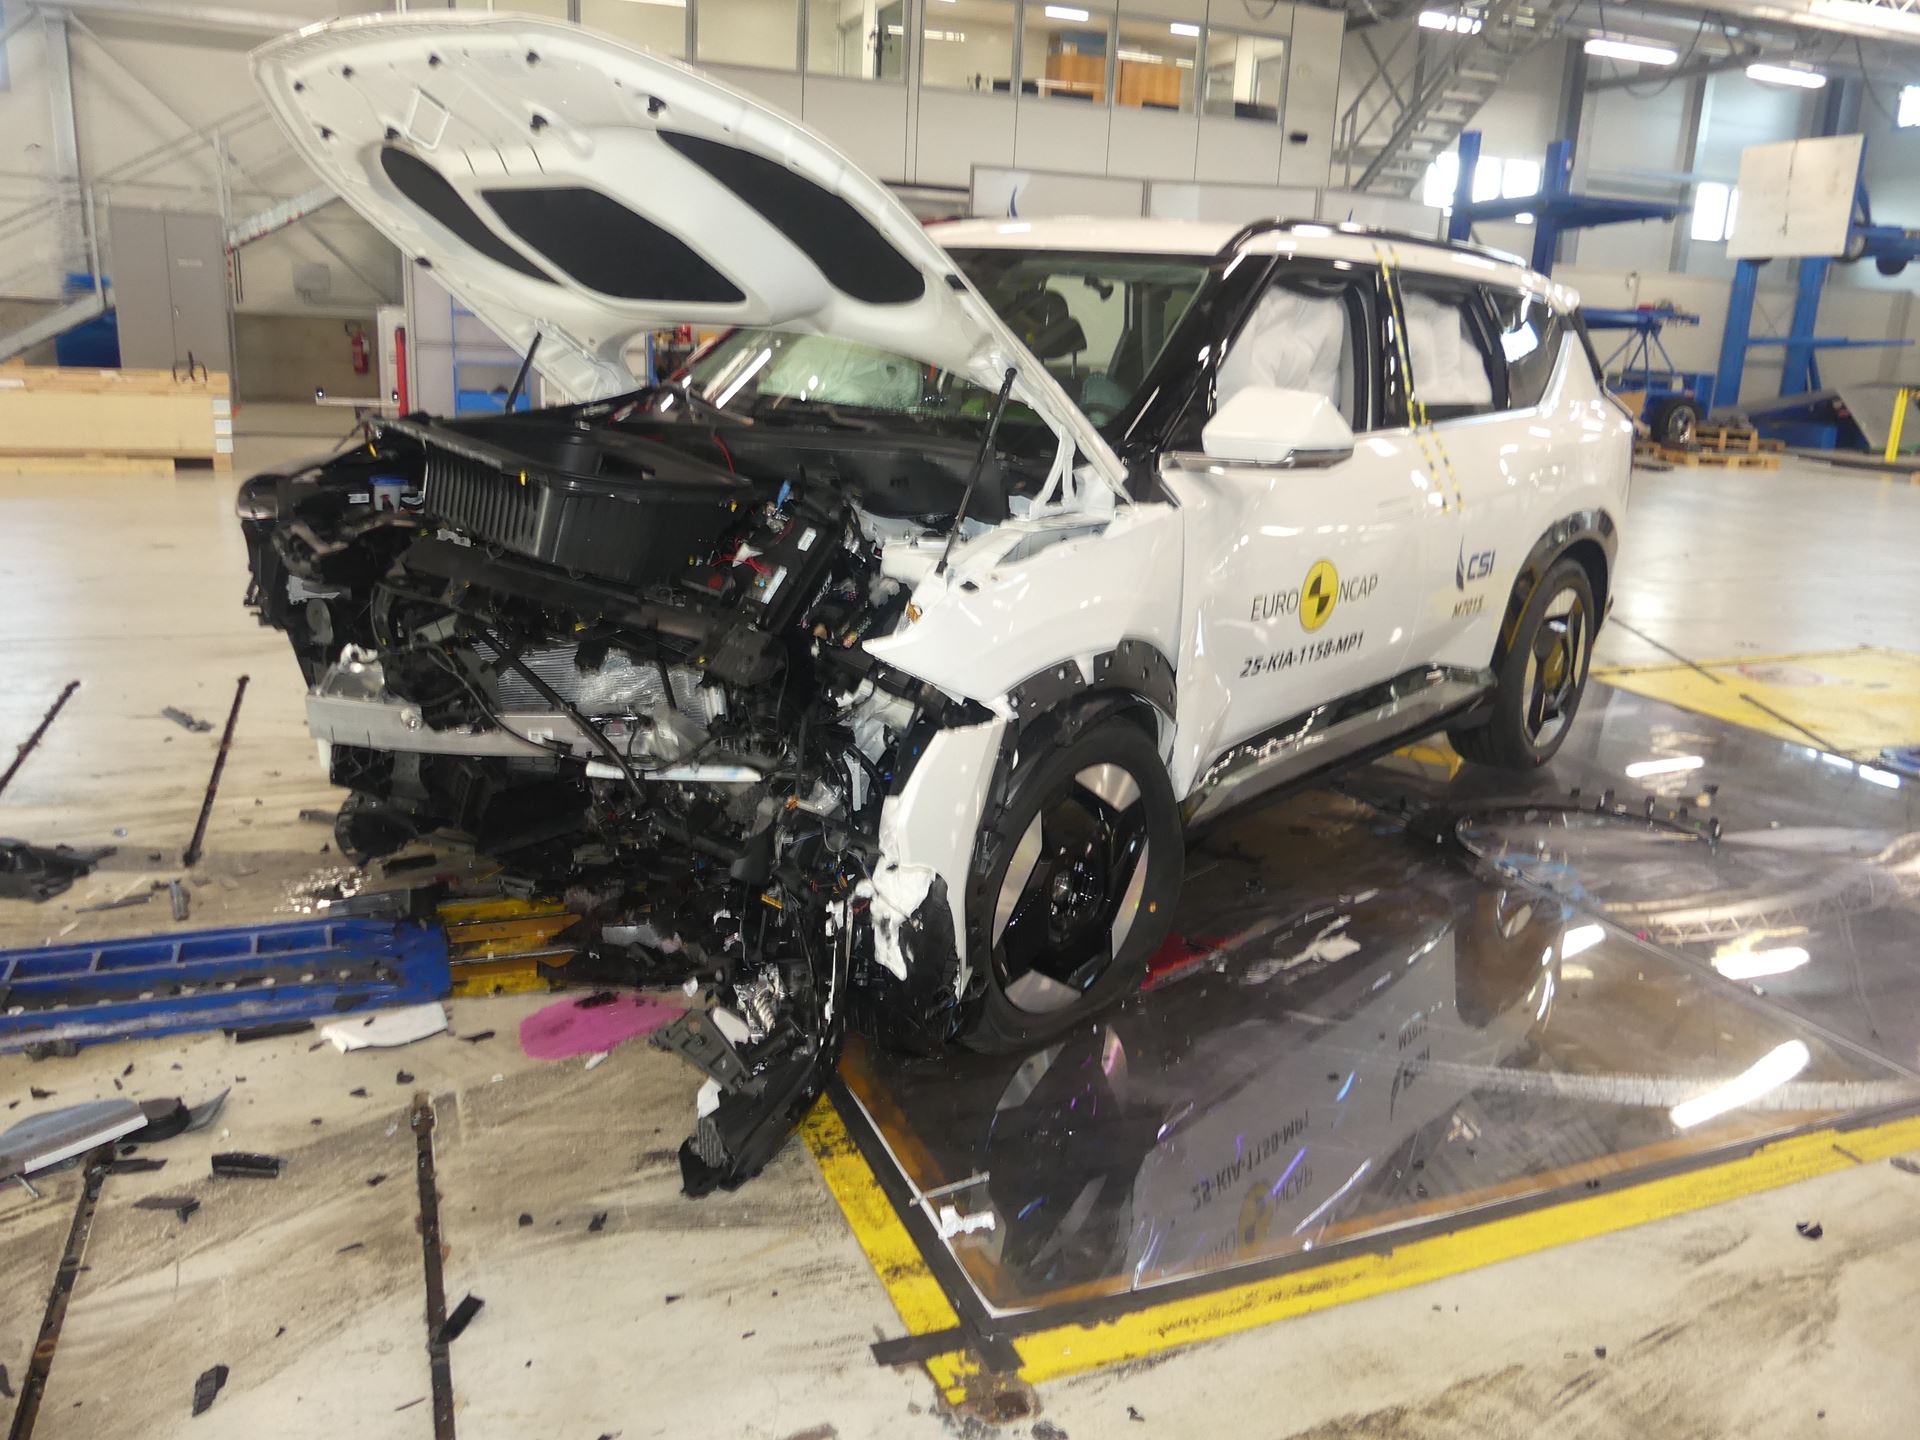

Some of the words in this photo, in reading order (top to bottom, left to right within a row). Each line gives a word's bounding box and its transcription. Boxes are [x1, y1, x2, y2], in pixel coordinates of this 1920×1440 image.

[1467, 550, 1496, 581] CSI
[1250, 591, 1299, 622] EURO
[1338, 573, 1379, 604] NCAP
